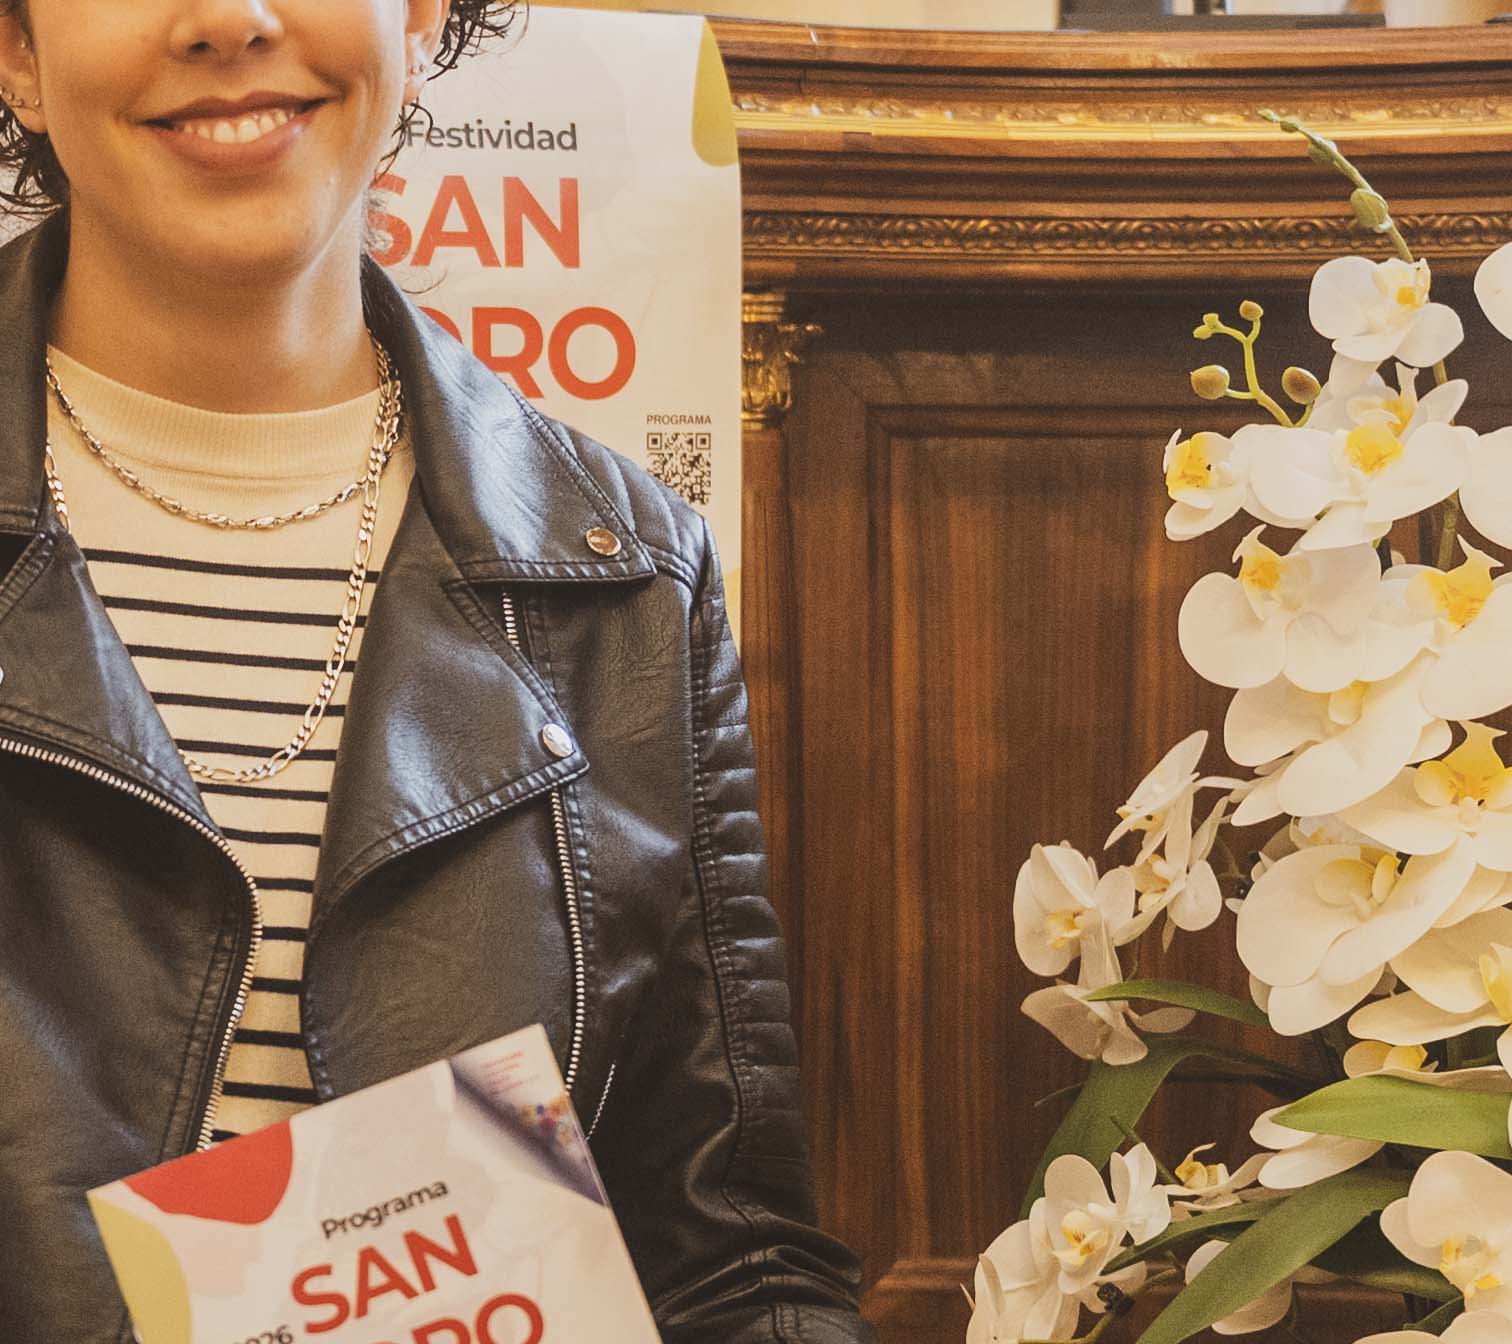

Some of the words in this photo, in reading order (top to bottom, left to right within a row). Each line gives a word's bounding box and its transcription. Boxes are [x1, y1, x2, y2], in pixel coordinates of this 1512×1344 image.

[407, 119, 577, 151] Festividad
[646, 414, 712, 425] PROGRAMA
[321, 1180, 449, 1239] Programa
[292, 1214, 479, 1334] SAN
